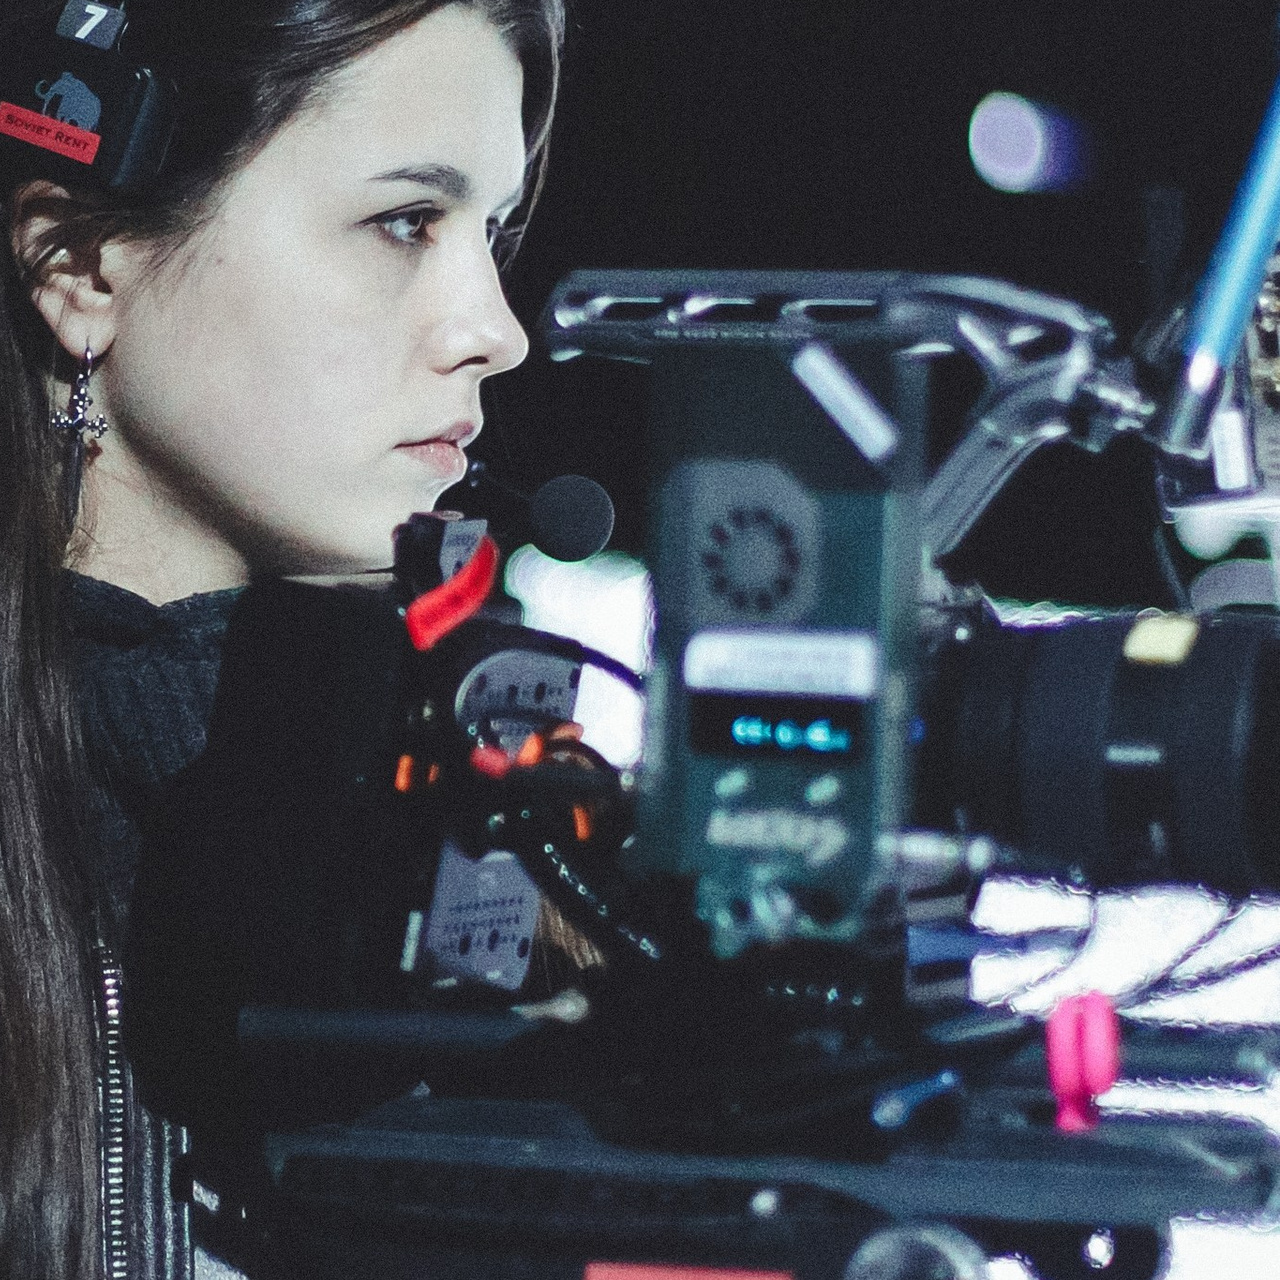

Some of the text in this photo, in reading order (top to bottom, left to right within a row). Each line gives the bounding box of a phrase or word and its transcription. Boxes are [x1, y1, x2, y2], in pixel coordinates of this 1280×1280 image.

[75, 4, 108, 39] 7
[5, 113, 90, 150] SOVIET RENT
